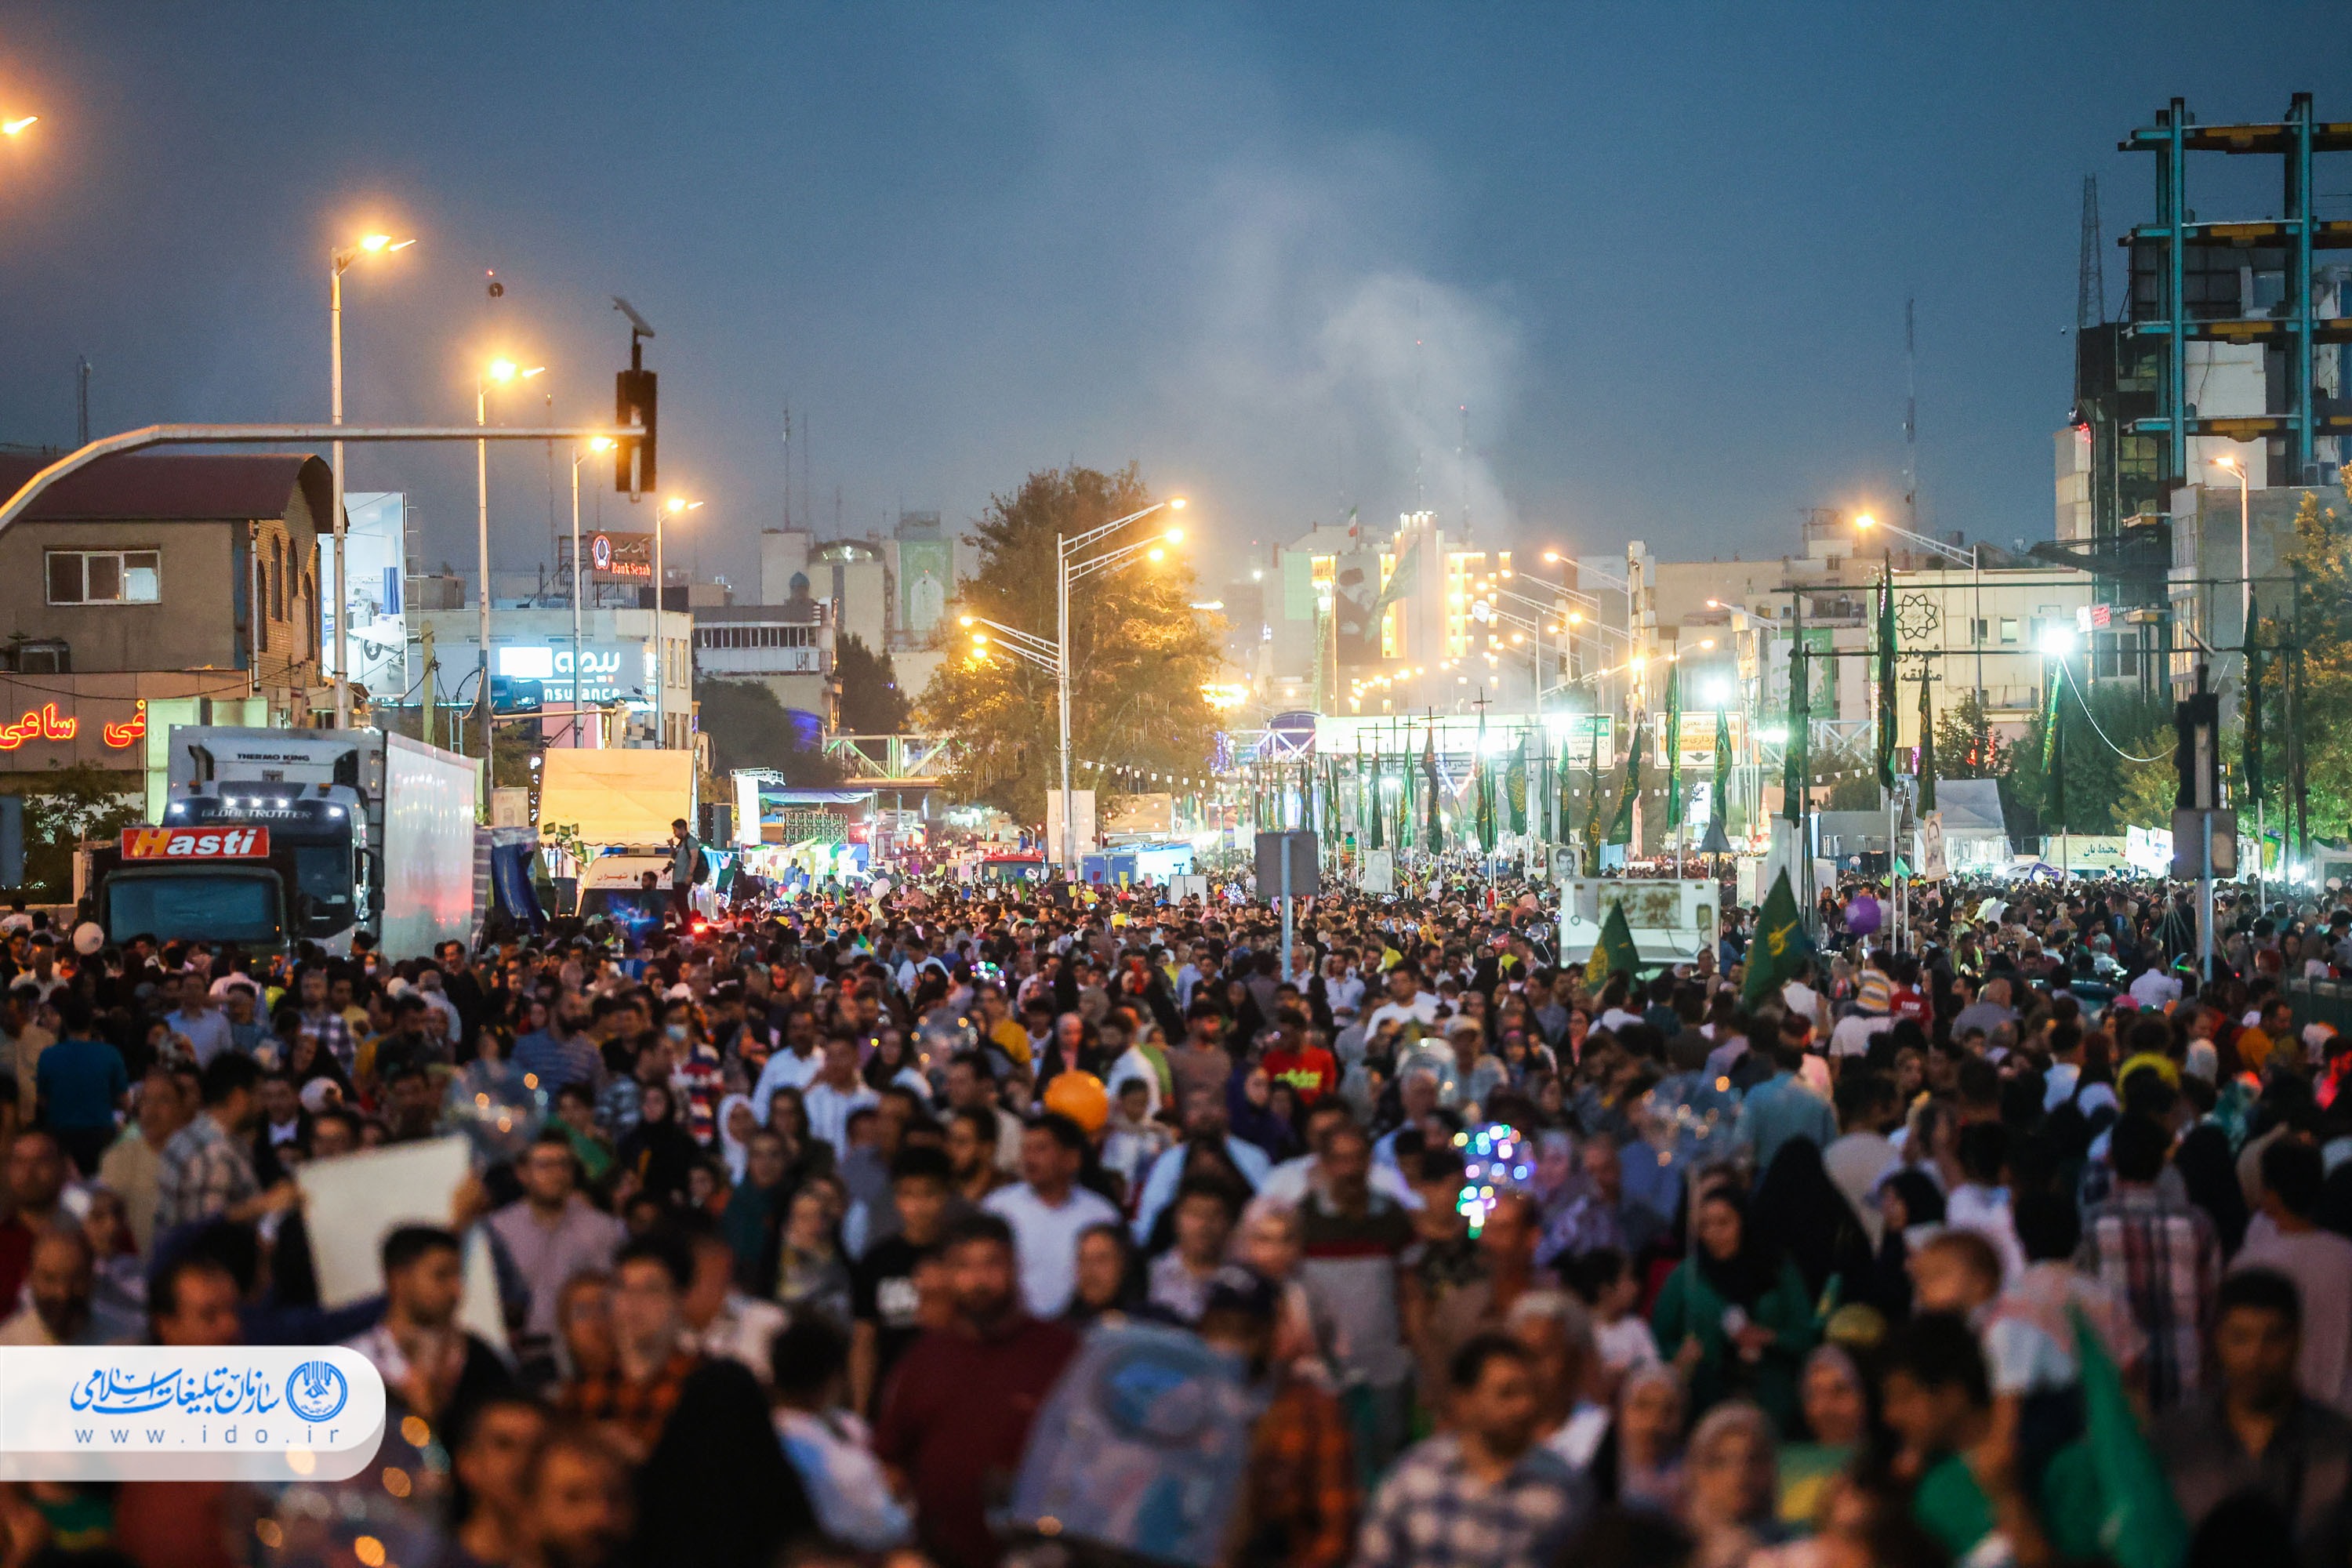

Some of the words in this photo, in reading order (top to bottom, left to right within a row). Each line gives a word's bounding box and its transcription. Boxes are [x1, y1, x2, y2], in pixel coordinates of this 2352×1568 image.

[612, 561, 630, 575] Bank
[544, 688, 620, 701] nsuance
[0, 702, 75, 750] ساعی
[237, 753, 281, 761] THERMO
[130, 829, 257, 856] Hasti
[597, 872, 629, 881] تهران
